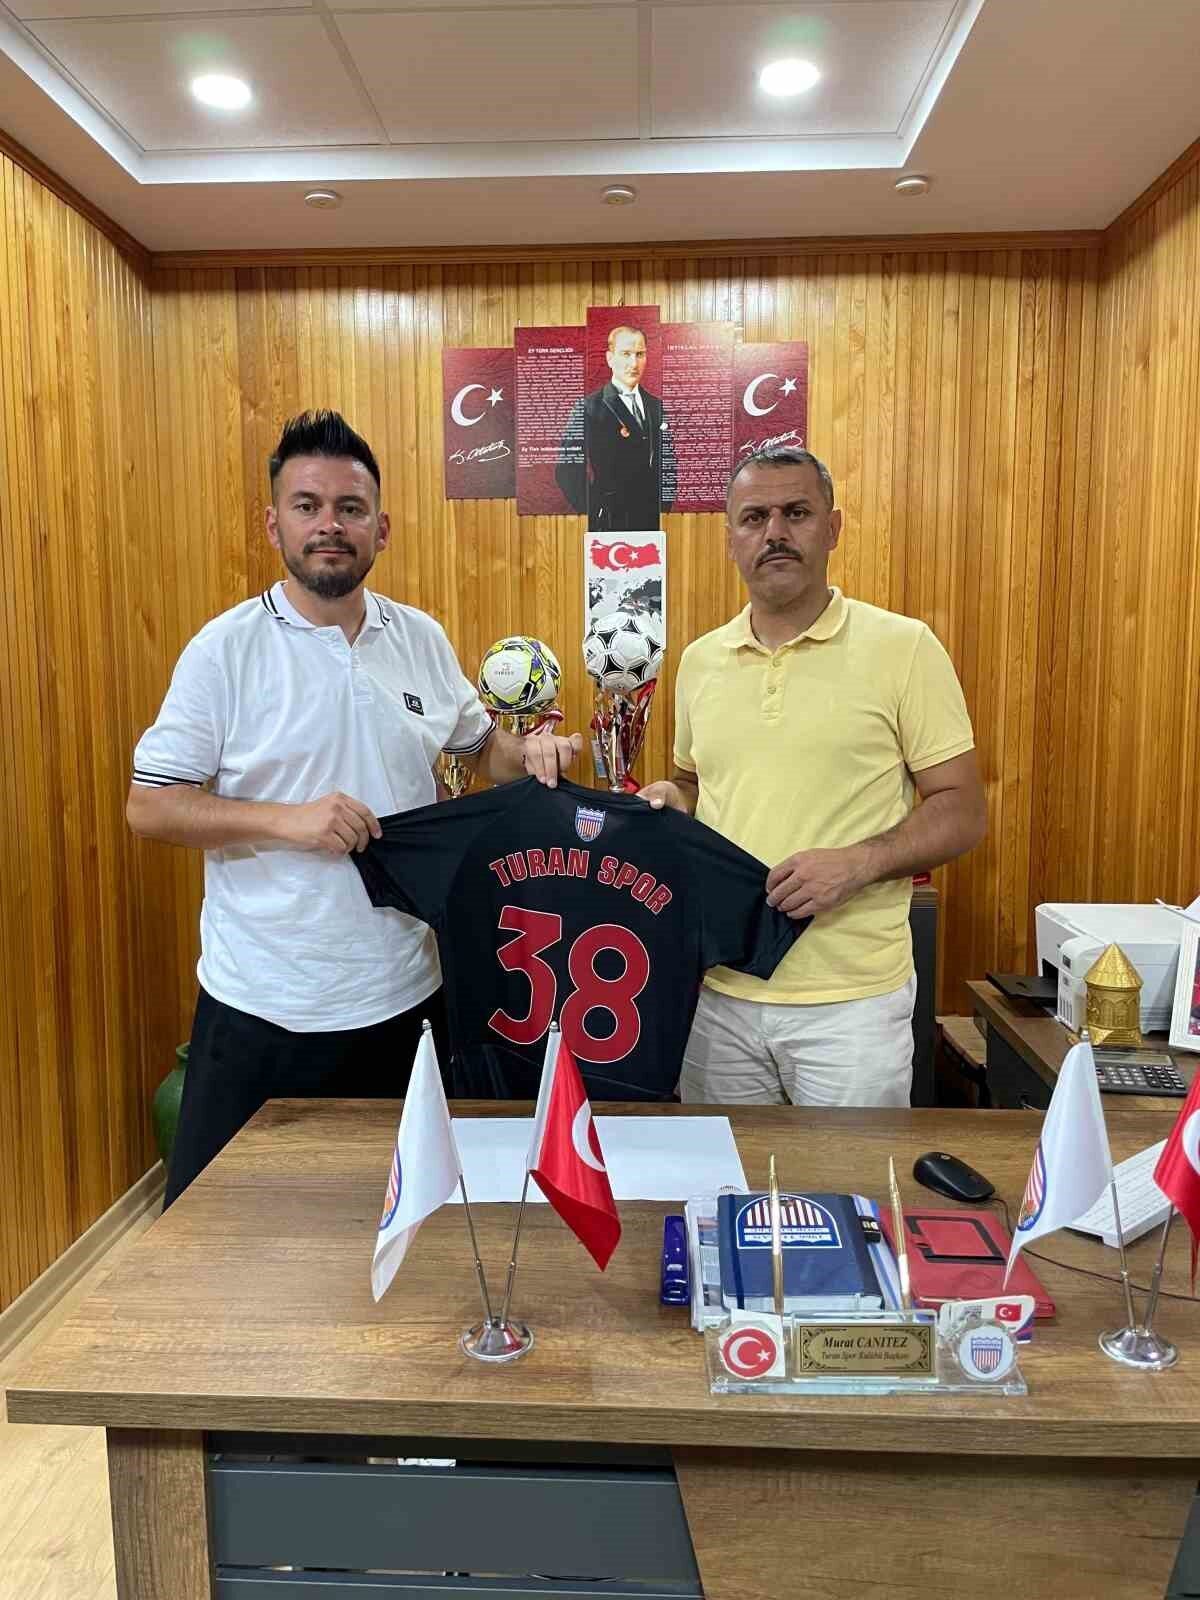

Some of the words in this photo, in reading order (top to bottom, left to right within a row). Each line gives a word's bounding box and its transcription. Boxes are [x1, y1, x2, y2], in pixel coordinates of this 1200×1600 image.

[488, 847, 590, 888] TURAN
[598, 854, 674, 916] SPOR
[488, 904, 651, 1064] 38
[823, 1336, 854, 1349] Murat
